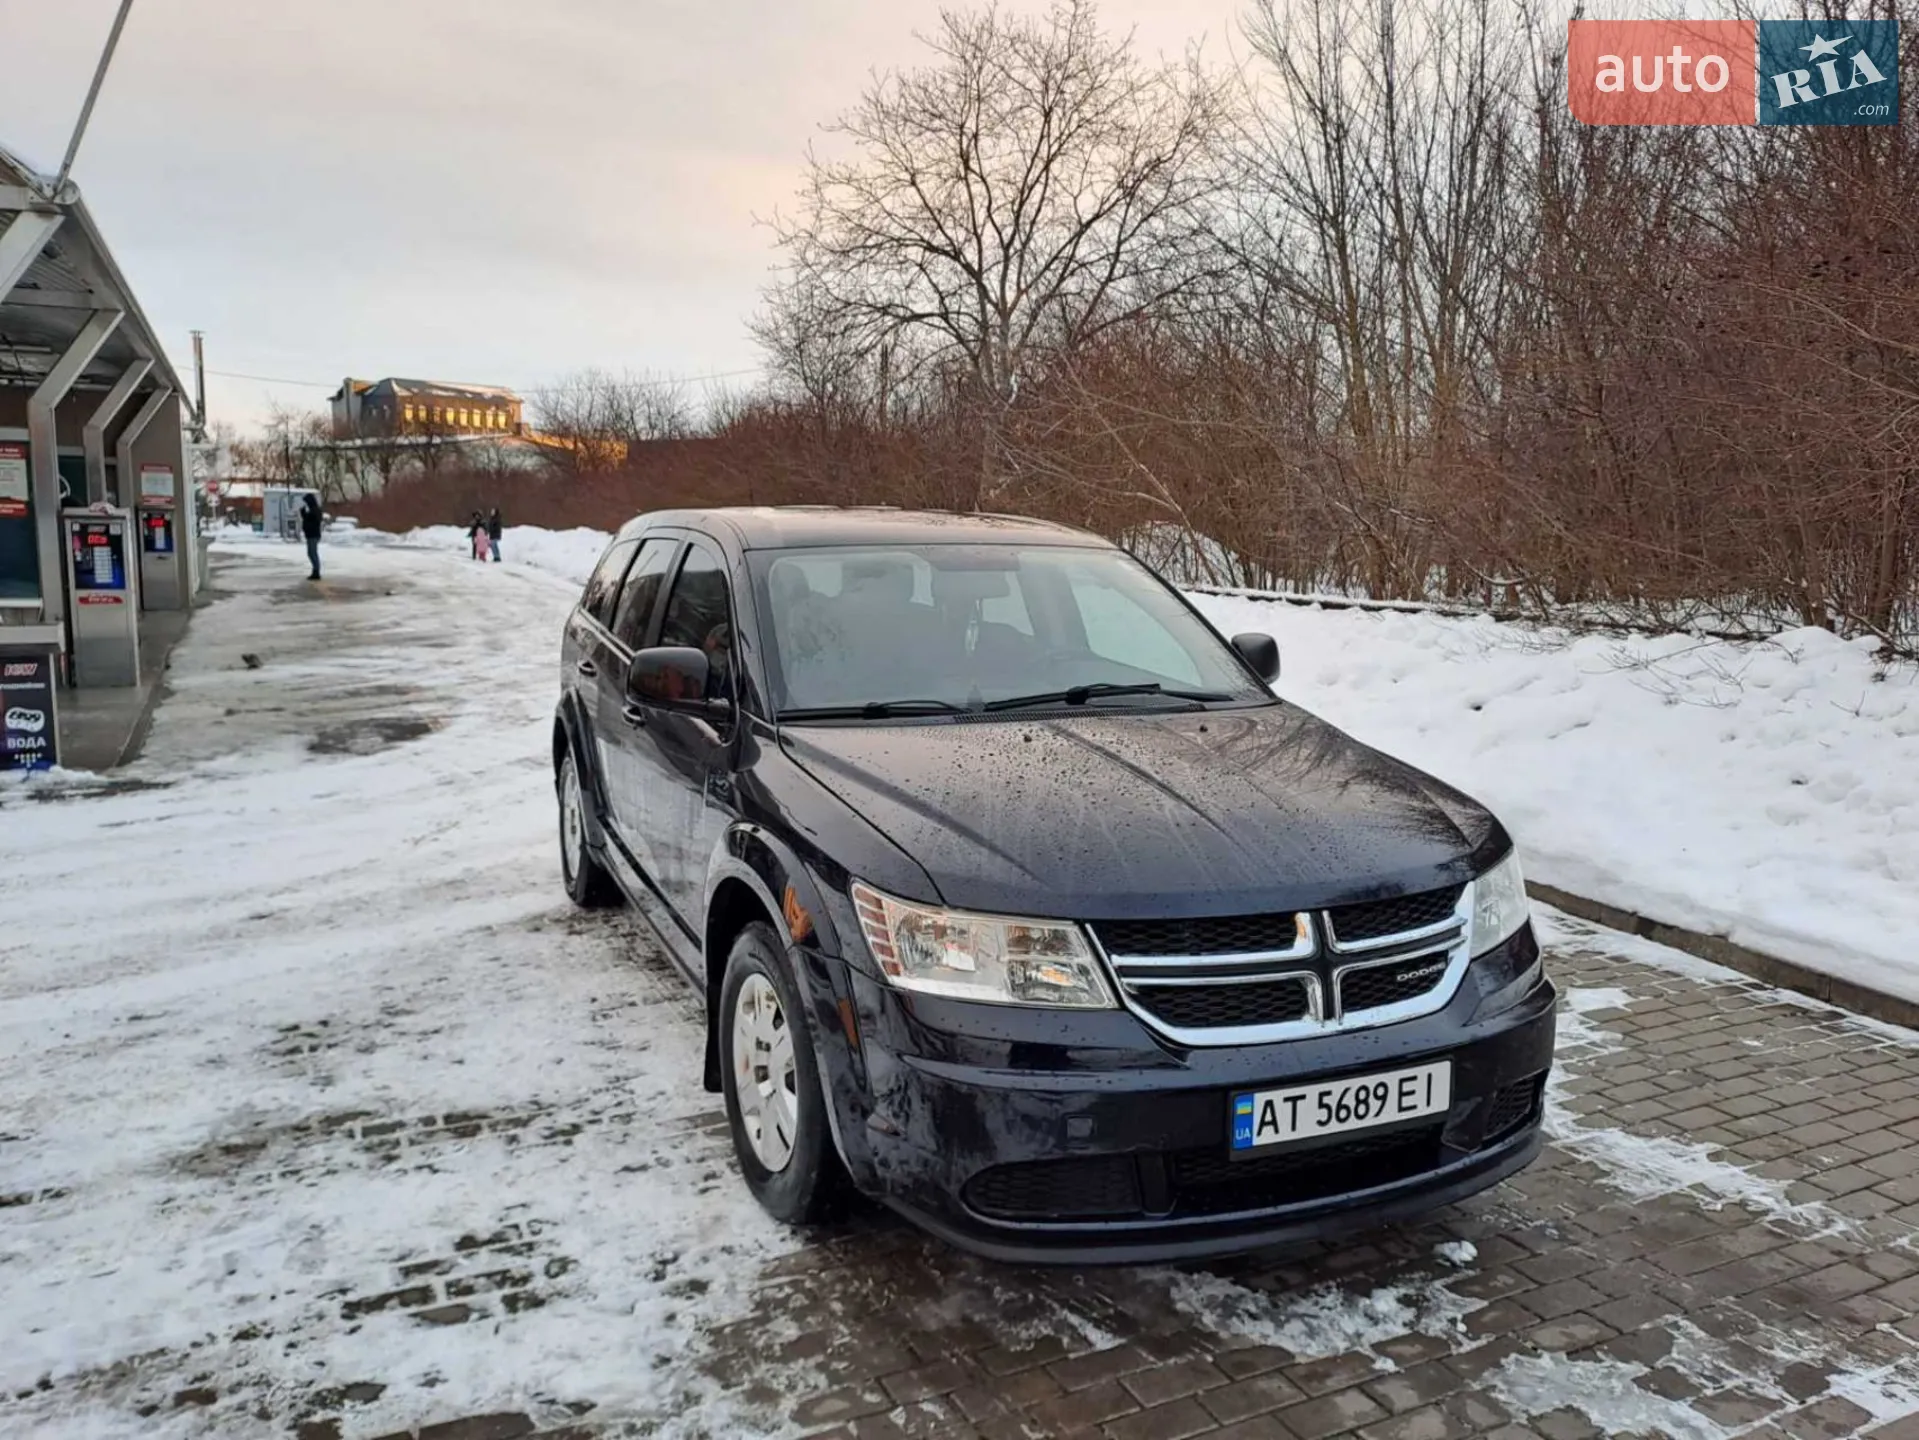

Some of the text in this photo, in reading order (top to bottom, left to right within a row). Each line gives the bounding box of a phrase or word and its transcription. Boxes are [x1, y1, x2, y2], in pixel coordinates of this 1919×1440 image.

[7, 736, 47, 749] ВОДА
[1256, 1073, 1432, 1137] AT 5689 EI
[1236, 1127, 1251, 1140] UA
